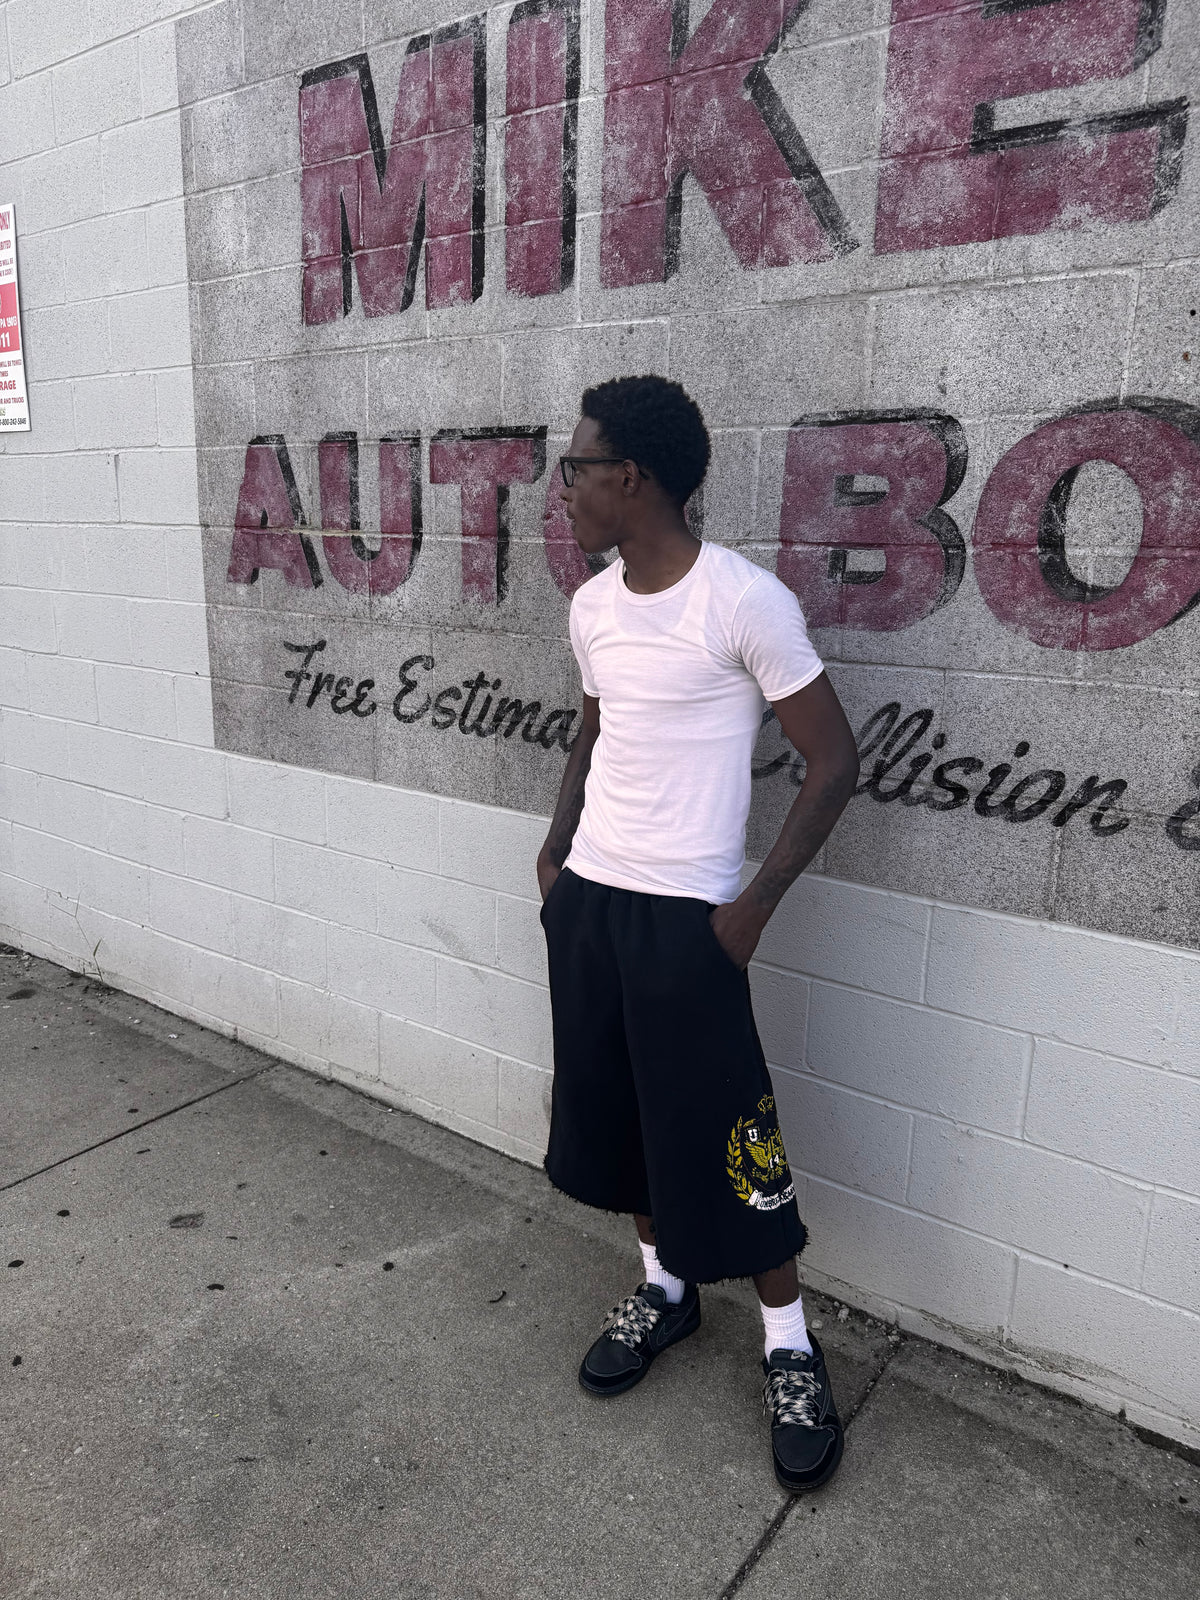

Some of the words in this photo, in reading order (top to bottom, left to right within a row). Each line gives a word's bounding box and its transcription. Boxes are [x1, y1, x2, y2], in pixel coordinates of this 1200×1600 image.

[300, 0, 1190, 326] MIKE
[0, 331, 10, 348] 11
[776, 395, 1200, 652] BO
[283, 639, 375, 718] Free
[751, 701, 1131, 838] llision
